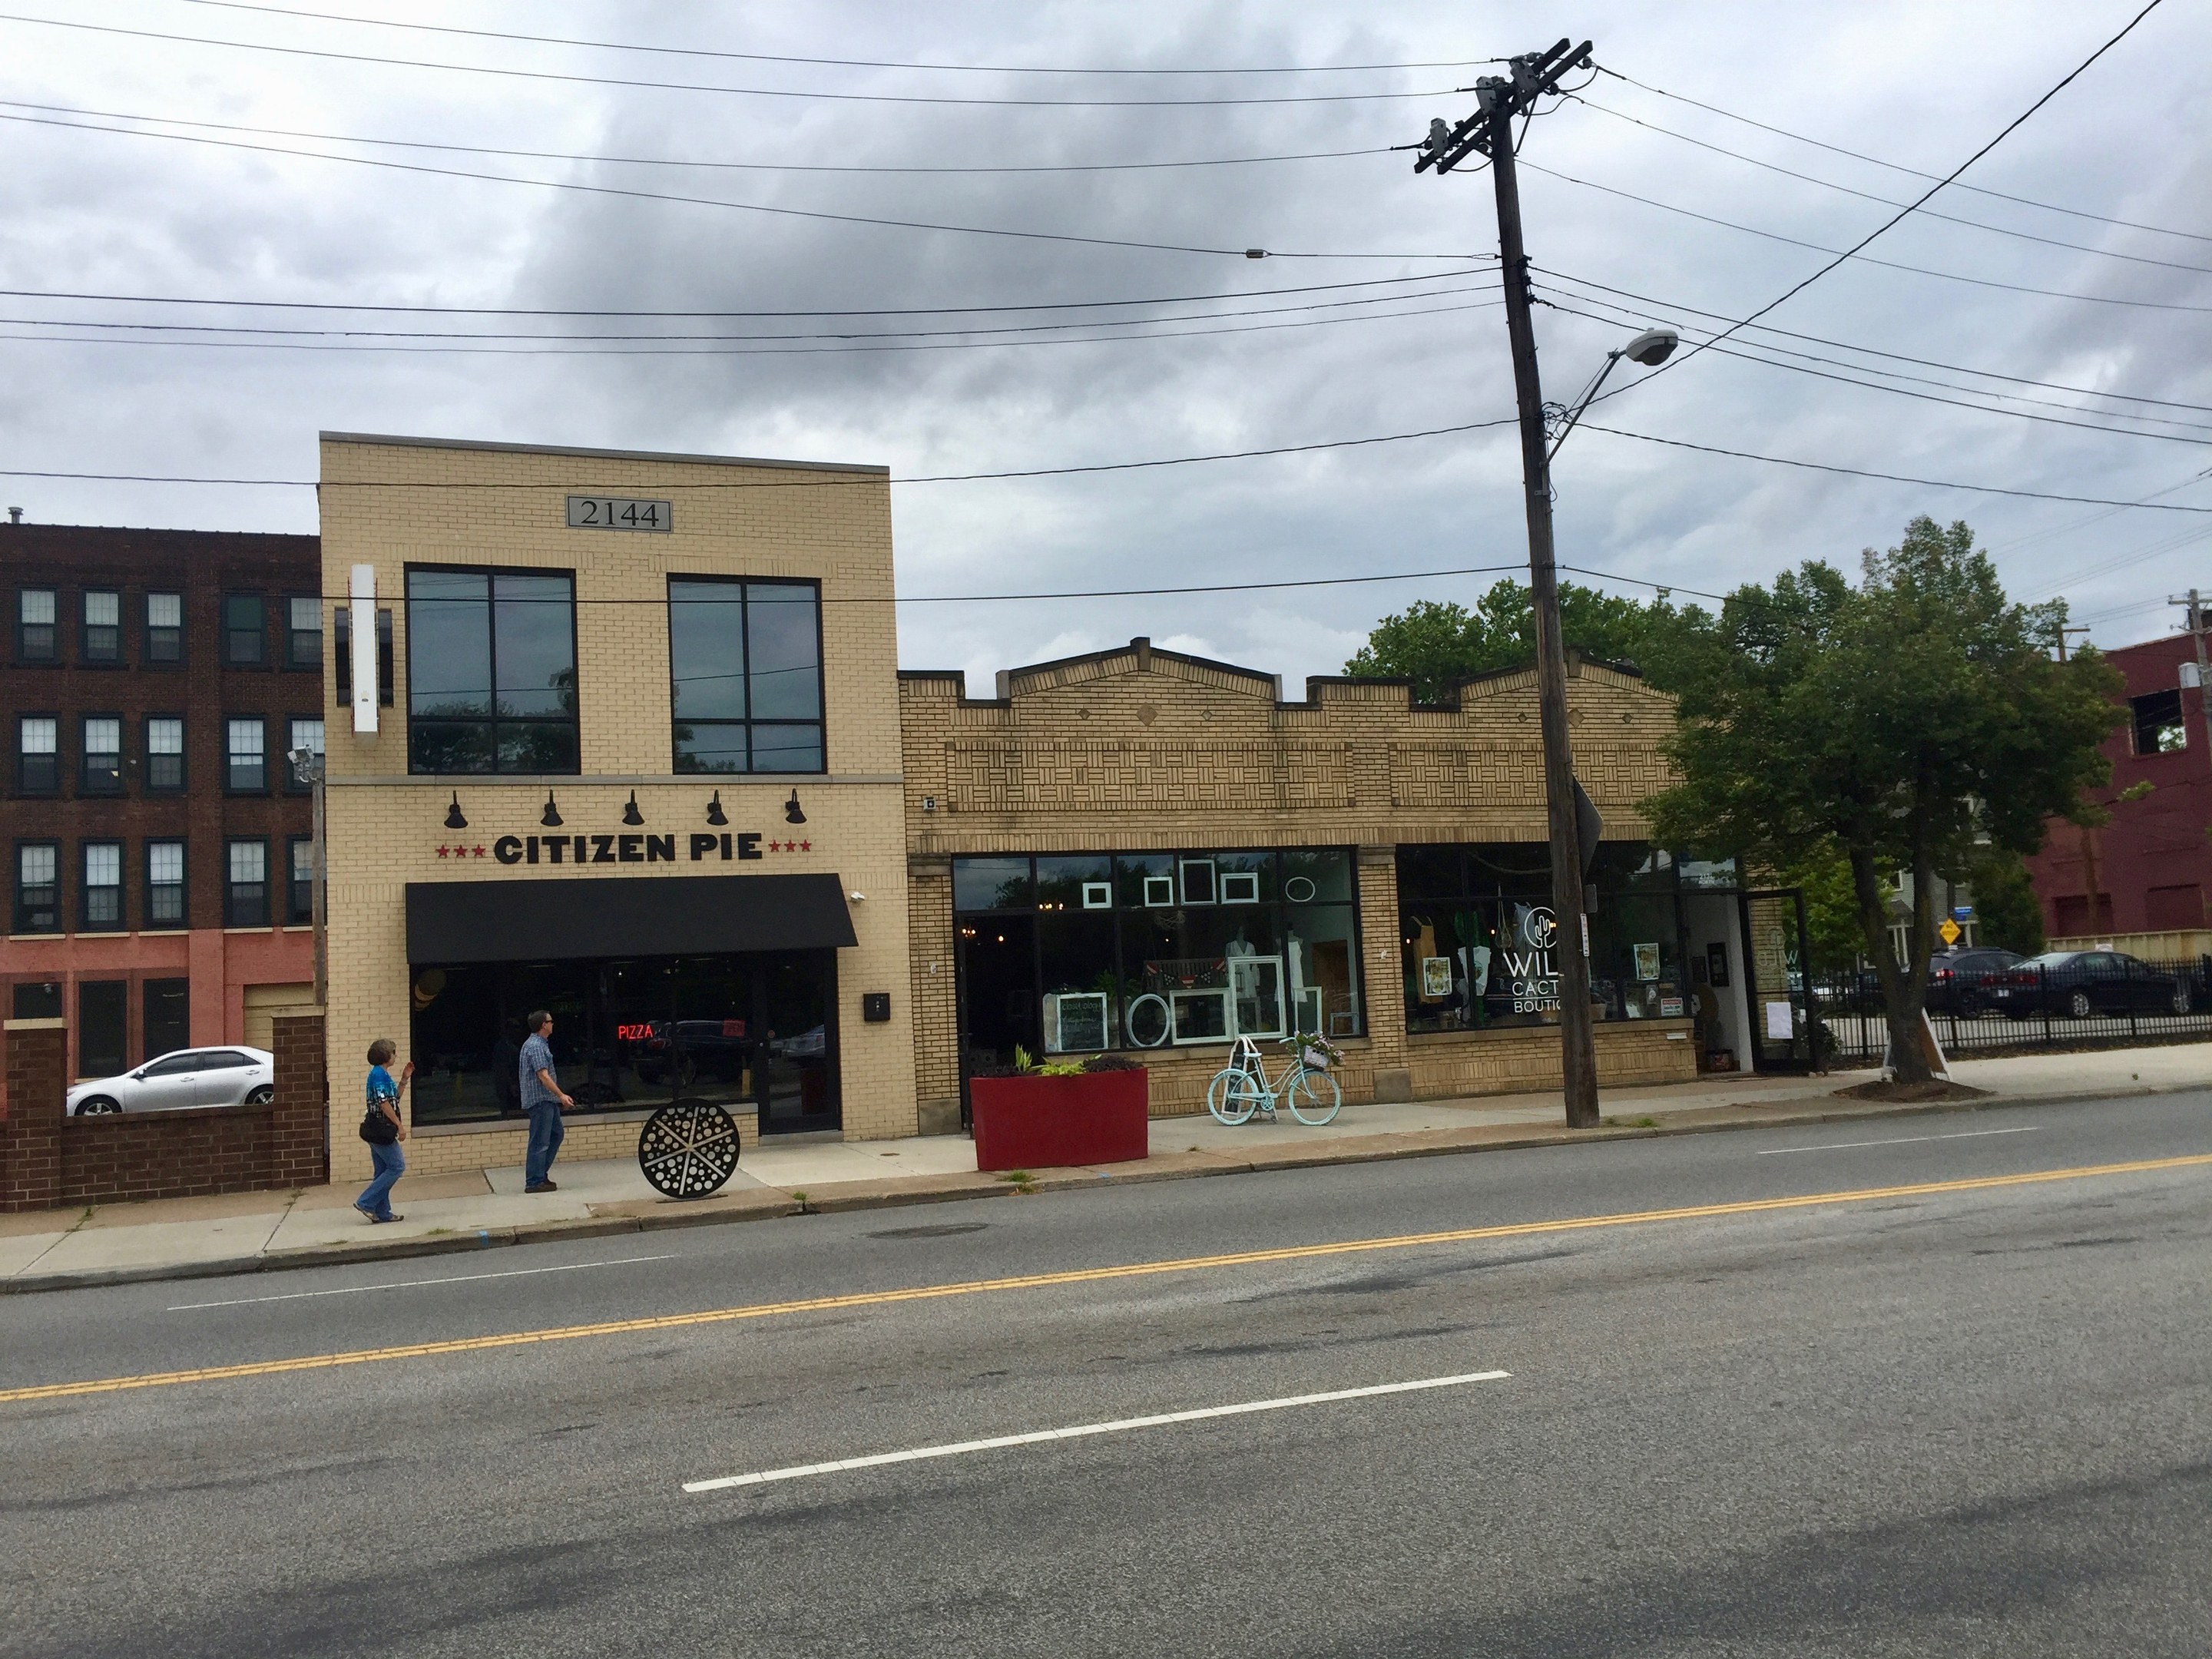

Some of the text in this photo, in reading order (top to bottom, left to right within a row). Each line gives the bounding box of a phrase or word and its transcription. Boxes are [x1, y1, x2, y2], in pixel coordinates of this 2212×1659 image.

[581, 500, 660, 528] 2144
[494, 833, 763, 865] CITIZEN PIE
[1502, 951, 1559, 978] WIL
[1512, 979, 1560, 997] CACT
[1514, 999, 1561, 1013] BOUTI
[618, 1024, 654, 1040] PIZZA
